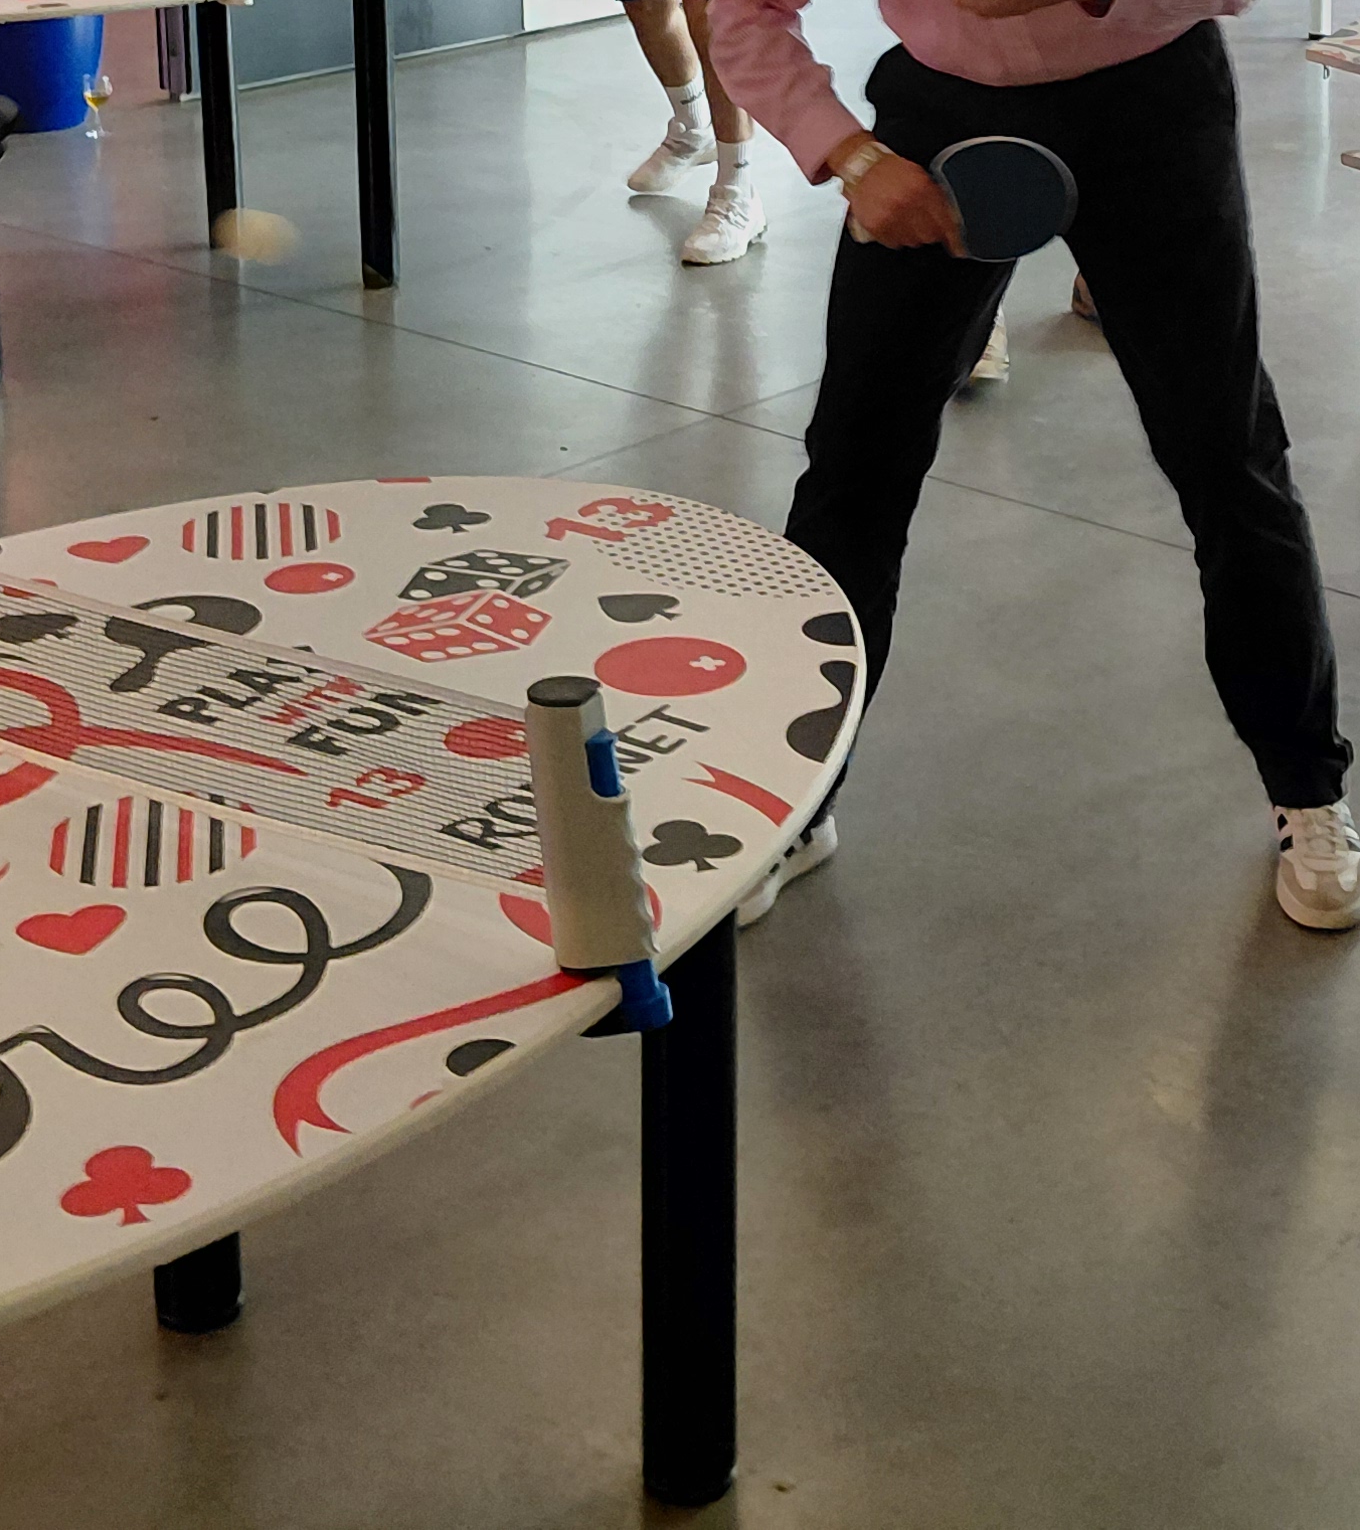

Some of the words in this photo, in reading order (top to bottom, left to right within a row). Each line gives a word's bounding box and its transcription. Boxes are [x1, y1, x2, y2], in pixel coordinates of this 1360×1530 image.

[544, 497, 676, 543] 13
[285, 691, 442, 756] FUN
[326, 767, 429, 810] 13
